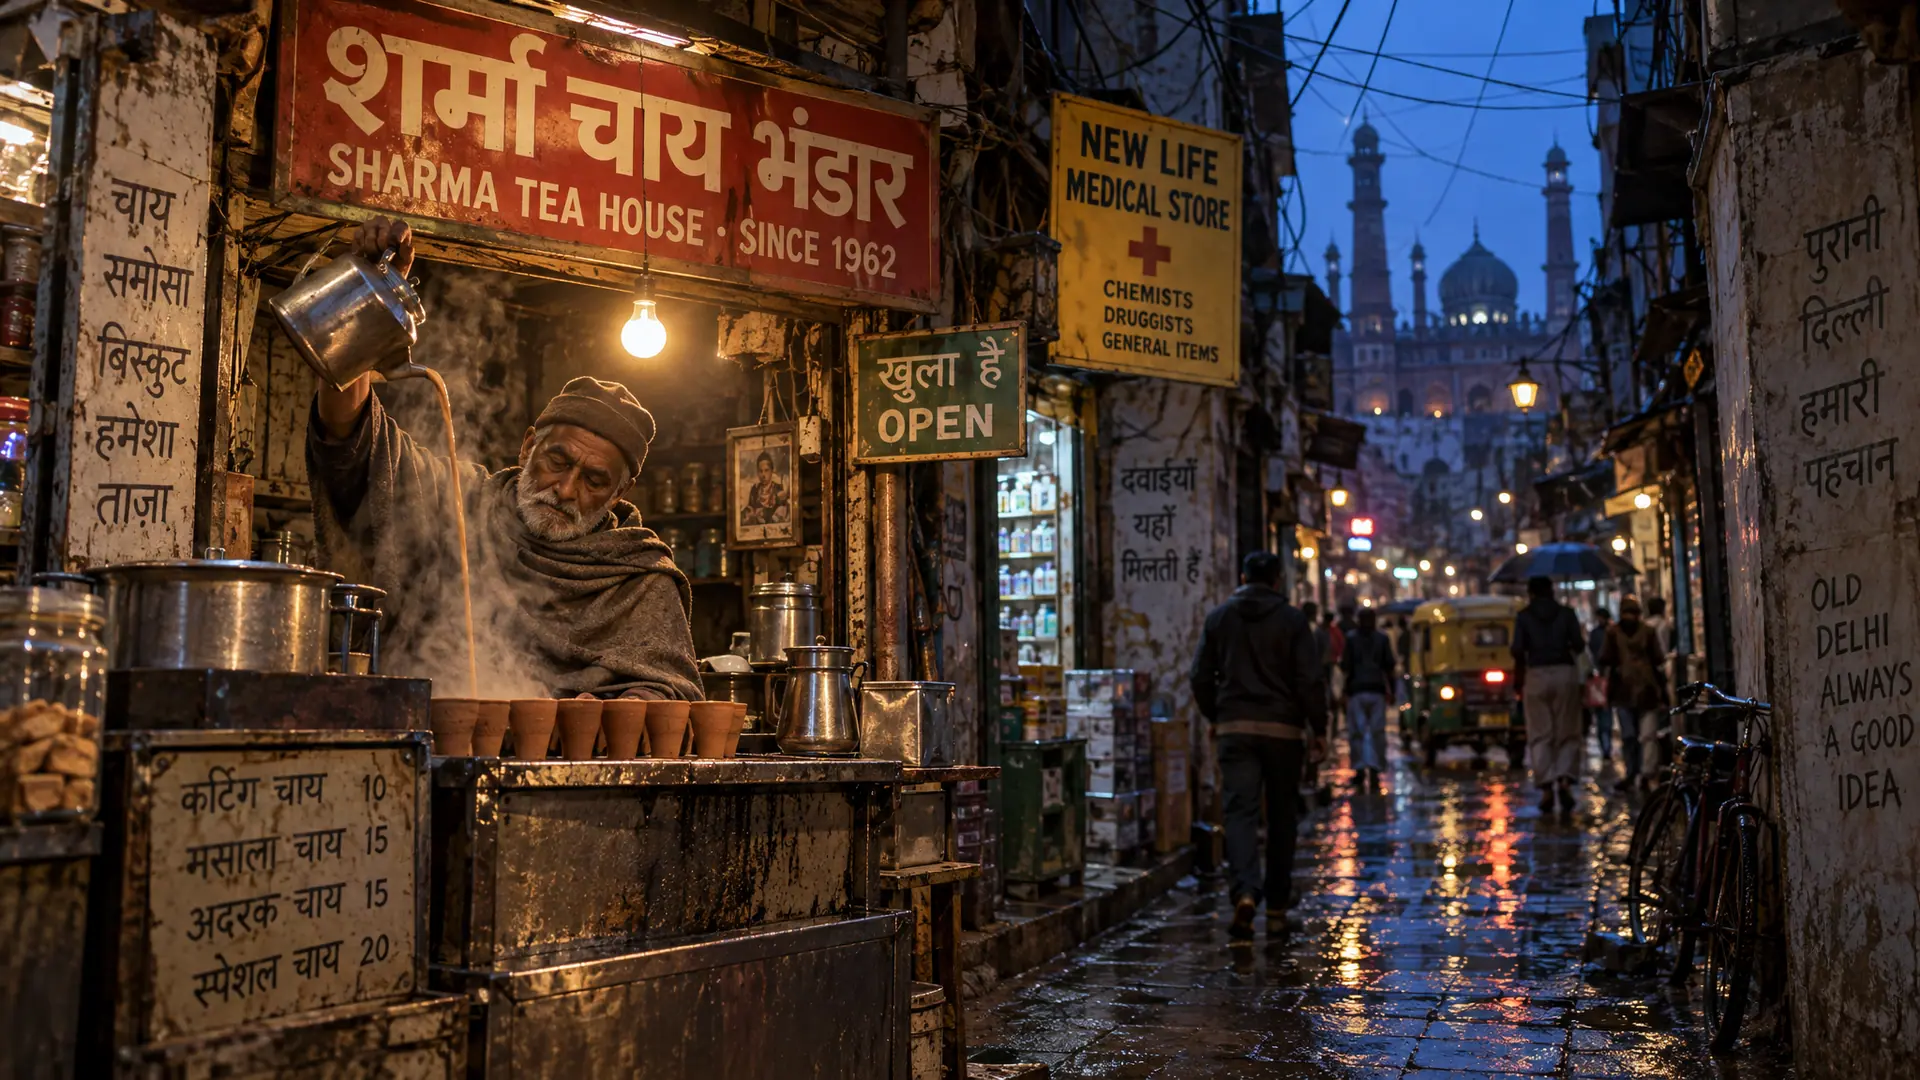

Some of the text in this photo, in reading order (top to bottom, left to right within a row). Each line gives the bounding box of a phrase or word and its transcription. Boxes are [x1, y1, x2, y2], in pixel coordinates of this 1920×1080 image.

[323, 26, 914, 229] शर्मा चाय भंडार
[1081, 121, 1218, 186] NEW LIFE
[111, 178, 176, 230] चाय
[327, 142, 499, 213] SHARMA
[515, 176, 585, 227] TEA
[599, 194, 704, 247] HOUSE
[739, 218, 820, 267] SINCE
[831, 236, 897, 279] 1962
[1066, 168, 1230, 231] MEDICAL STORE
[1803, 194, 1886, 284] पुरानी
[103, 246, 194, 308] समोसा
[1103, 279, 1193, 309] CHEMISTS
[1104, 306, 1193, 335] DRUGGISTS
[1798, 275, 1890, 353] दिल्ली
[97, 321, 191, 399] बिस्कुट
[877, 336, 1005, 403] खुला है
[1102, 332, 1219, 363] GENERAL ITEMS
[878, 403, 993, 443] OPEN
[1800, 358, 1885, 437] हमारी
[96, 401, 180, 461] हमेशा
[1803, 437, 1899, 499] पहचान
[97, 483, 174, 528] ताज़ा
[1120, 546, 1202, 584] मिलती हैं
[1811, 573, 1862, 611] OLD
[1816, 612, 1889, 659] DELHI
[1820, 661, 1913, 709] ALWAYS
[1824, 713, 1914, 758] A GOOD
[273, 773, 328, 806] चाय
[362, 774, 387, 802] 10
[1838, 767, 1902, 812] IDEA
[186, 825, 388, 879] मसाला चाय 15
[187, 878, 388, 942] अदरक चाय 15
[192, 934, 389, 1008] स्पेशल चाय 20
